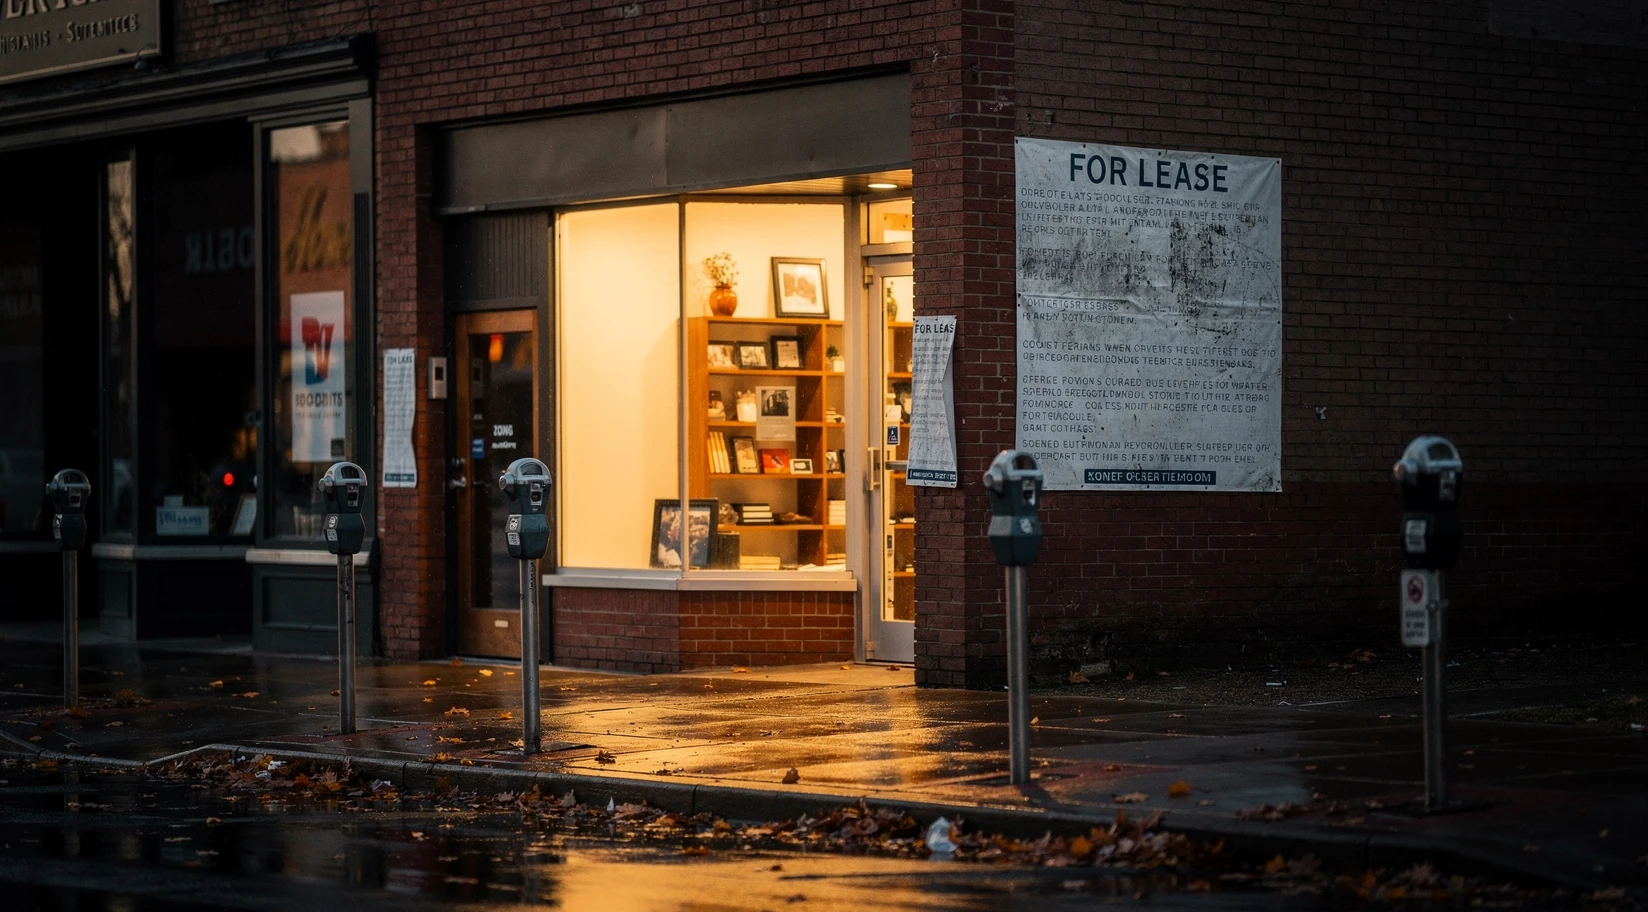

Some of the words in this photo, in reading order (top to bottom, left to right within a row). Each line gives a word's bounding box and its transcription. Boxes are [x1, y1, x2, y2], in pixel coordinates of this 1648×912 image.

[1070, 152, 1127, 186] FOR
[1138, 158, 1228, 193] LEASE
[915, 323, 932, 334] FOR
